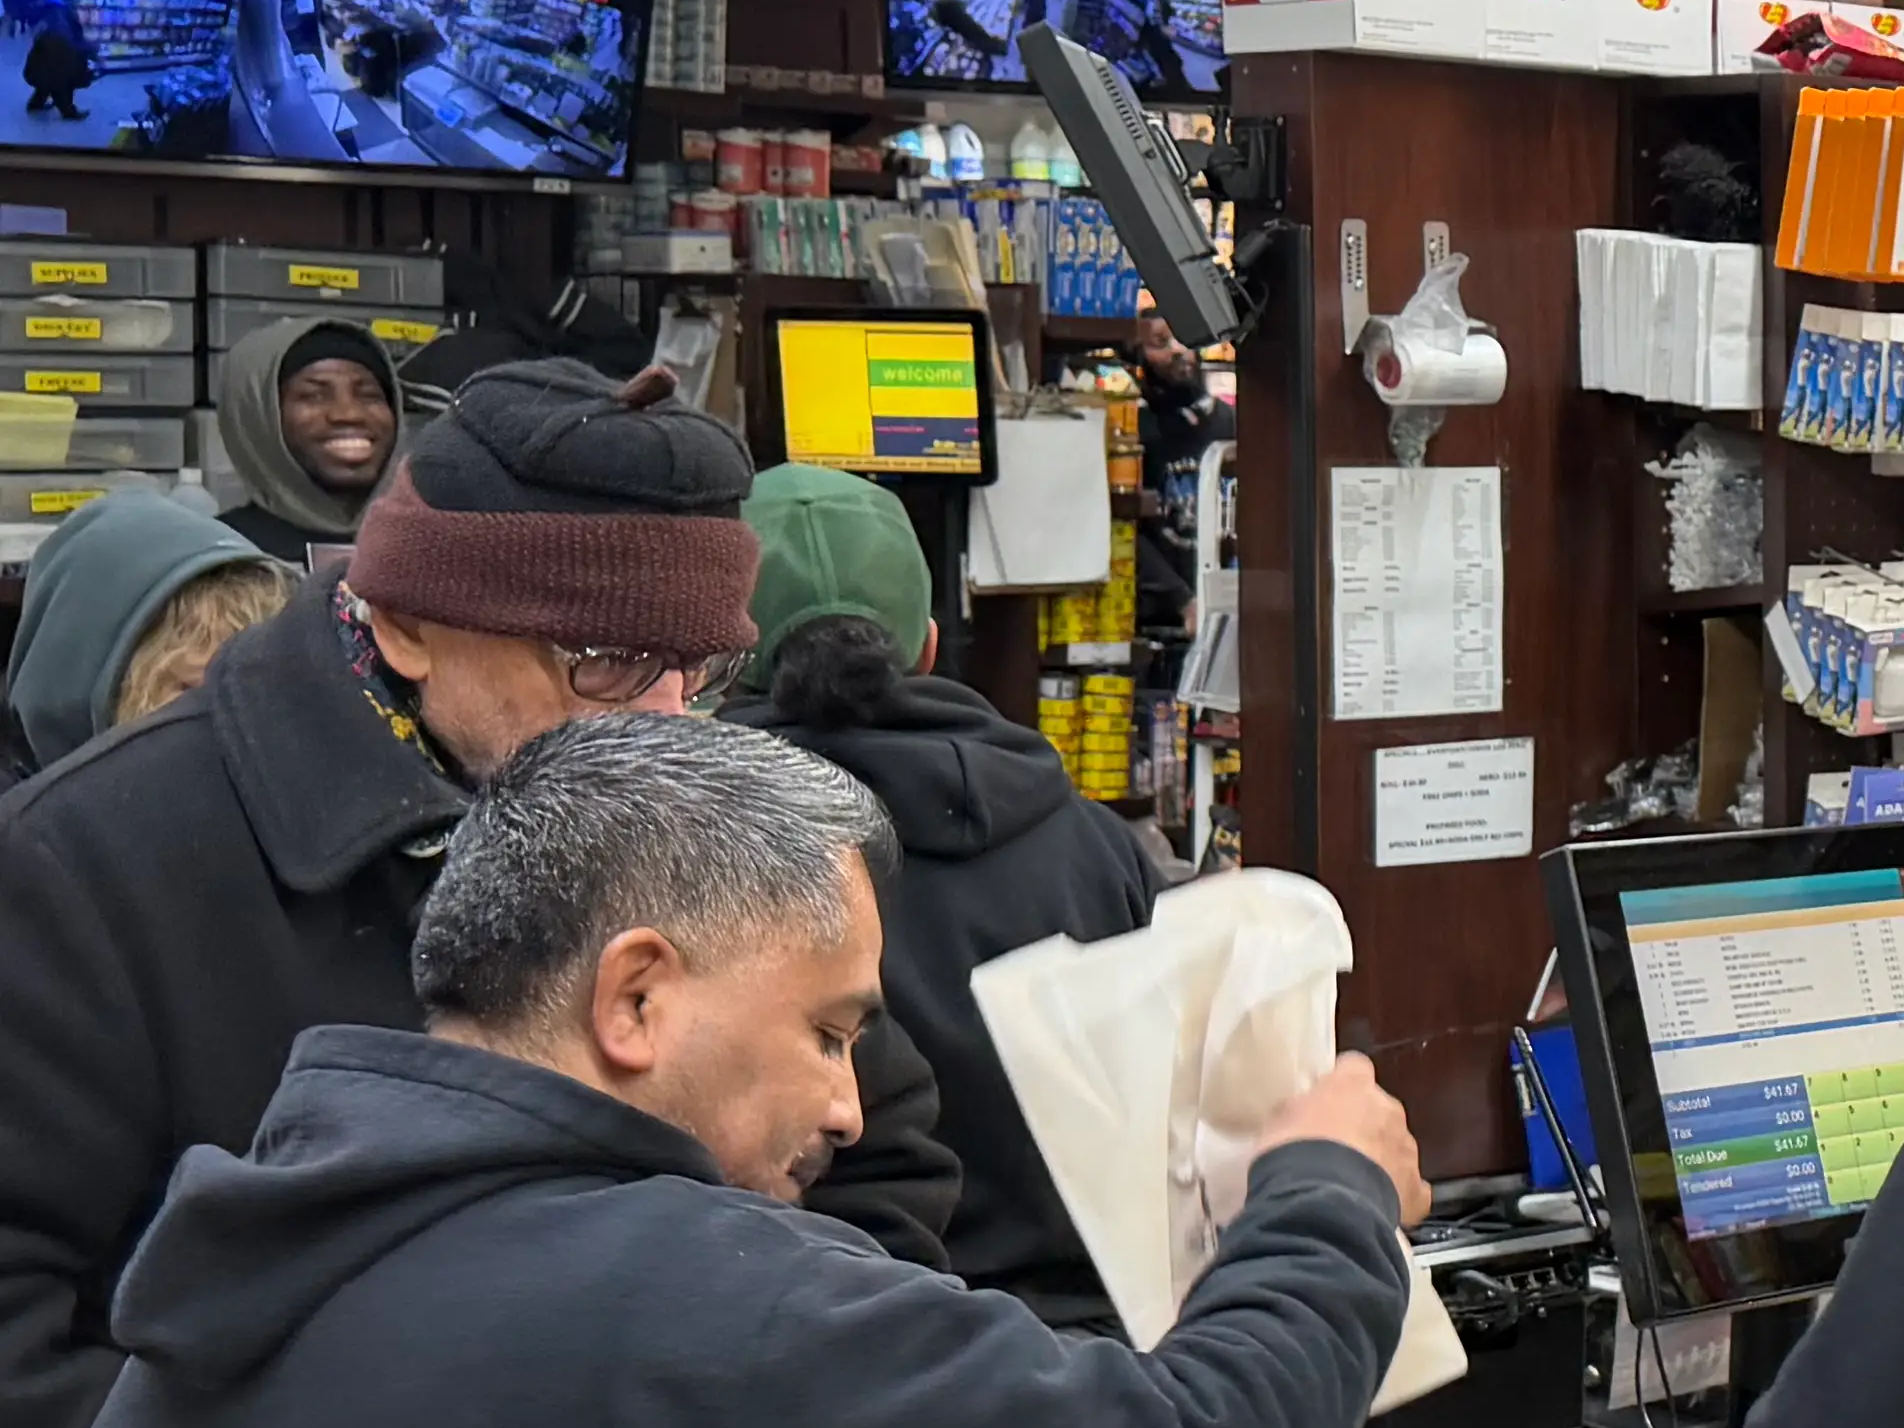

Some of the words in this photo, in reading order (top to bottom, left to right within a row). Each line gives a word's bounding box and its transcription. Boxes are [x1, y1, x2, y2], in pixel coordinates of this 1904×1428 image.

[881, 365, 965, 384] welcome
[1665, 1095, 1712, 1113] Subtotal
[1763, 1082, 1799, 1100] $41.67
[1671, 1126, 1694, 1141] Tax
[1775, 1110, 1805, 1125] $0.00
[1677, 1151, 1706, 1167] Total
[1706, 1149, 1729, 1164] Due
[1773, 1135, 1809, 1153] $41.67
[1682, 1176, 1734, 1195] Tendered
[1785, 1161, 1816, 1179] $0.00
